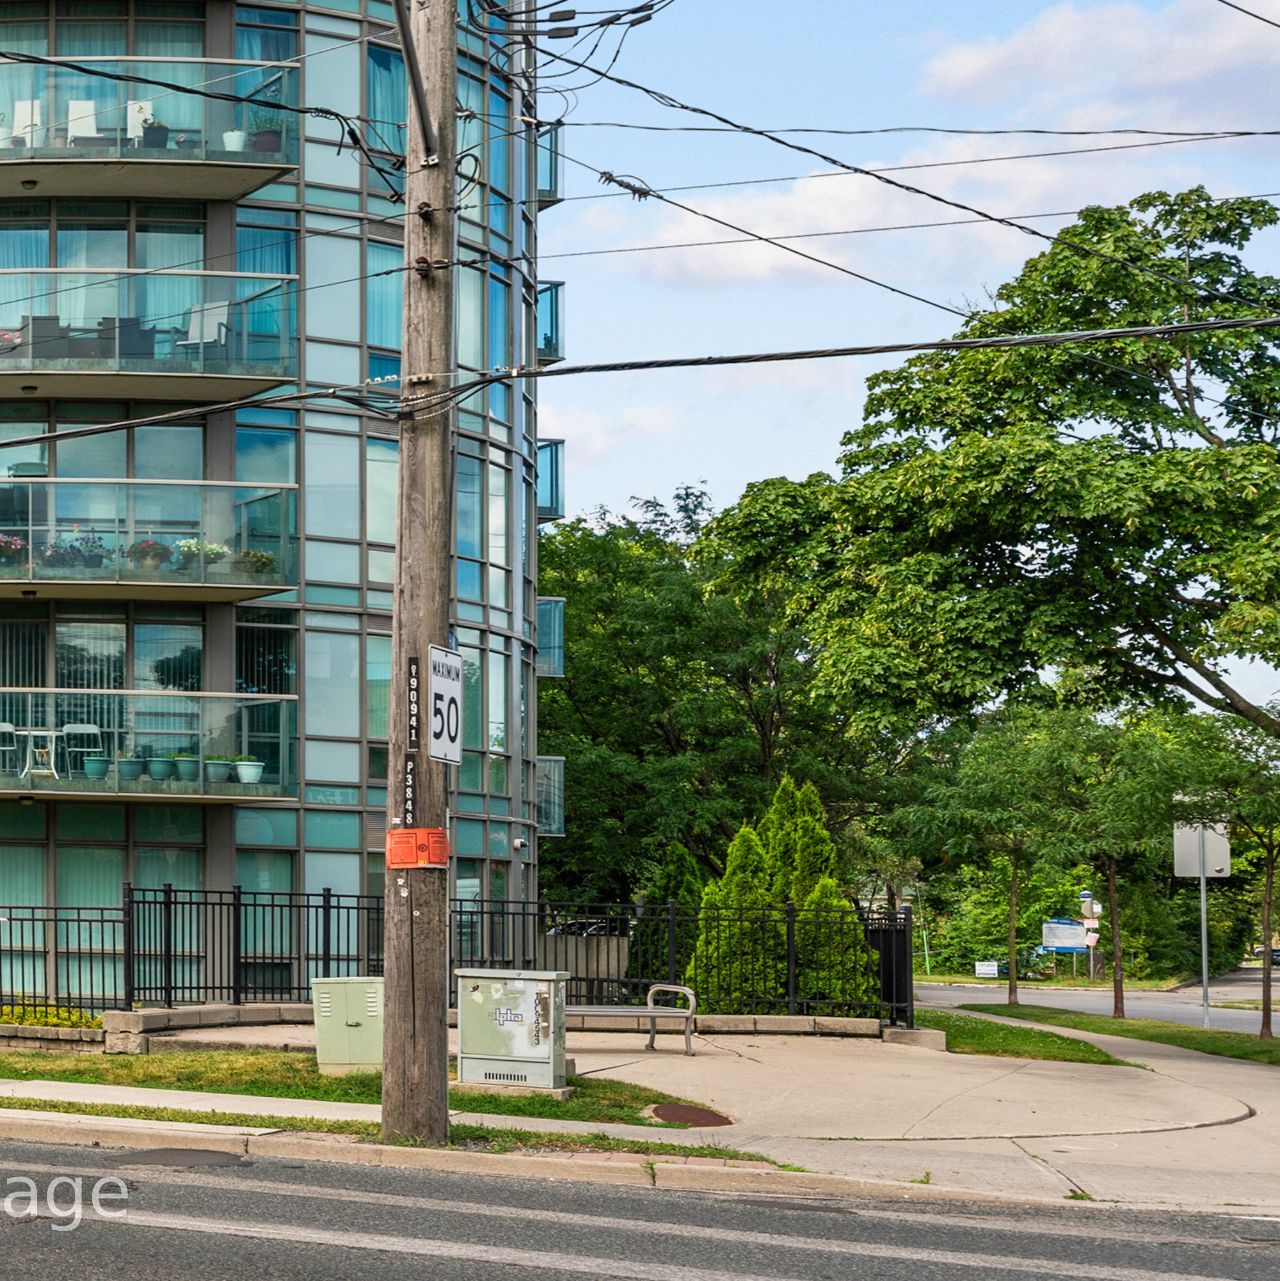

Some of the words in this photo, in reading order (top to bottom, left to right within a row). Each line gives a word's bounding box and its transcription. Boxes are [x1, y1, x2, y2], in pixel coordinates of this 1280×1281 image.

[432, 660, 460, 682] MAXIMUM
[433, 692, 459, 744] 50
[405, 761, 414, 825] P3848
